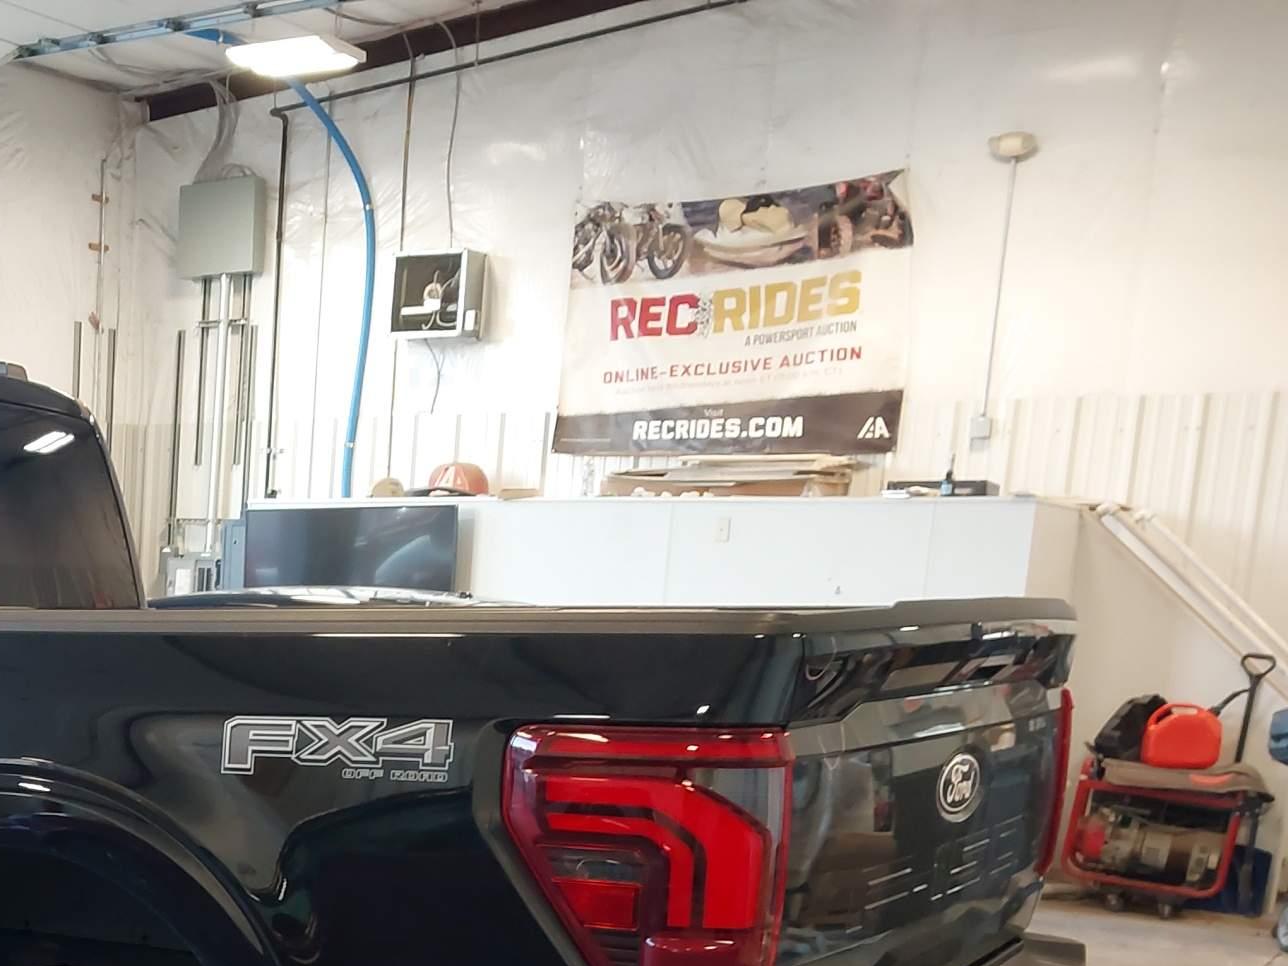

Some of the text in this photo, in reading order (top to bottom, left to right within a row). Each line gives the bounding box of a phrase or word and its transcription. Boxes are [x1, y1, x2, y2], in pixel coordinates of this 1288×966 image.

[610, 269, 862, 341] REC RIDES
[745, 320, 857, 347] A POWERSPORT AUCTION
[603, 357, 772, 384] ONLINE-EXCLUSIVE
[779, 346, 863, 369] AUCTION
[703, 408, 724, 417] Visit
[632, 415, 804, 440] RECRIDES.COM
[221, 715, 454, 775] FX4
[342, 768, 448, 782] OFF ROAD
